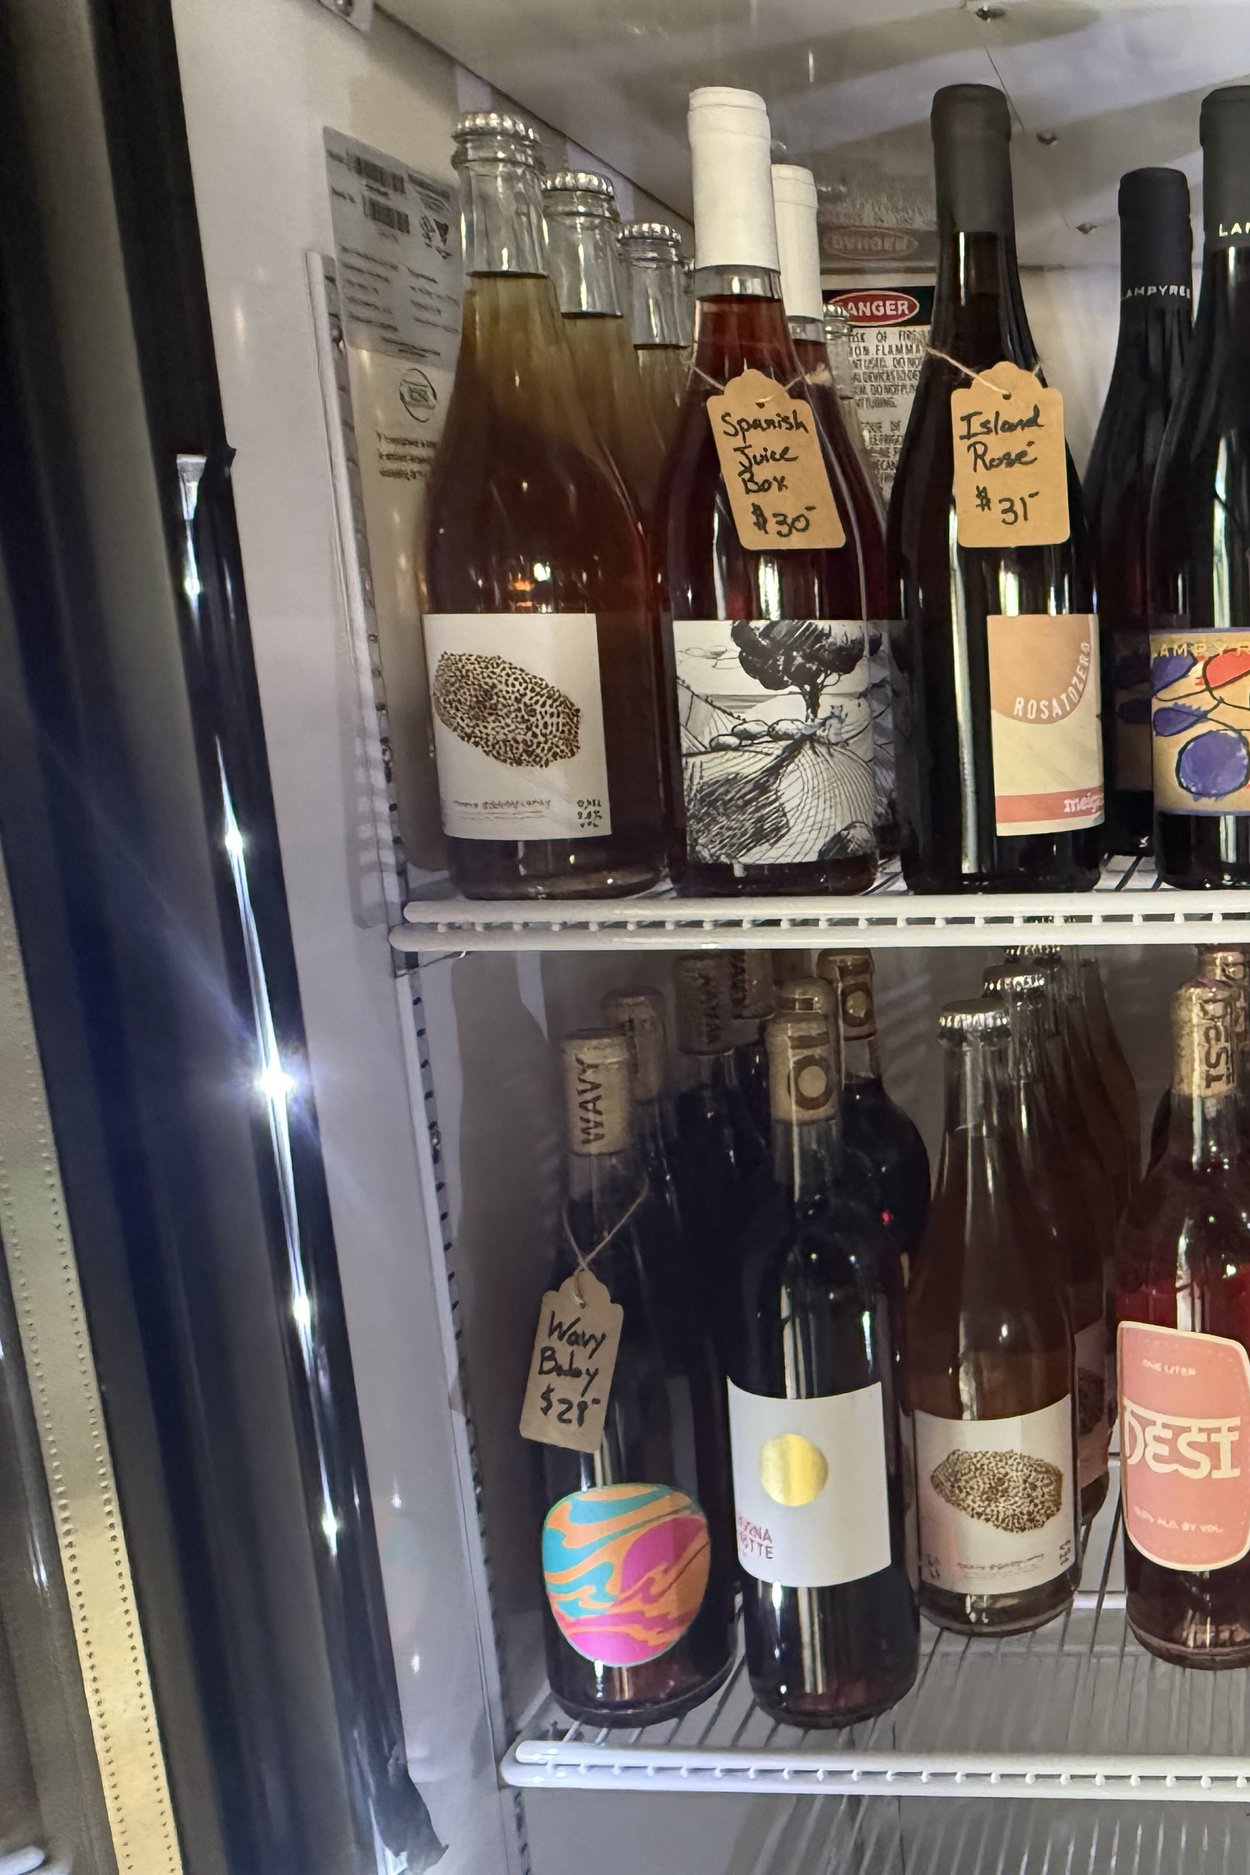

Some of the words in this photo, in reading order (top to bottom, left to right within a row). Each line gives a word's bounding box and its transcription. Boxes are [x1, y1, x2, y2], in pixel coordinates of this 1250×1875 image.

[846, 300, 909, 317] ANGER
[1122, 284, 1191, 300] AMPYRE
[875, 343, 921, 356] FLAMMA
[720, 409, 810, 445] Spanish
[959, 403, 1045, 441] Island
[732, 444, 800, 470] Juice
[966, 440, 1038, 473] Rosé
[737, 469, 789, 495] Box
[1013, 641, 1090, 720] ROSATOZERO
[575, 1055, 606, 1145] WAVY
[547, 1310, 606, 1360] Wavy
[538, 1346, 599, 1398] Baby
[1123, 1396, 1242, 1480] DESI
